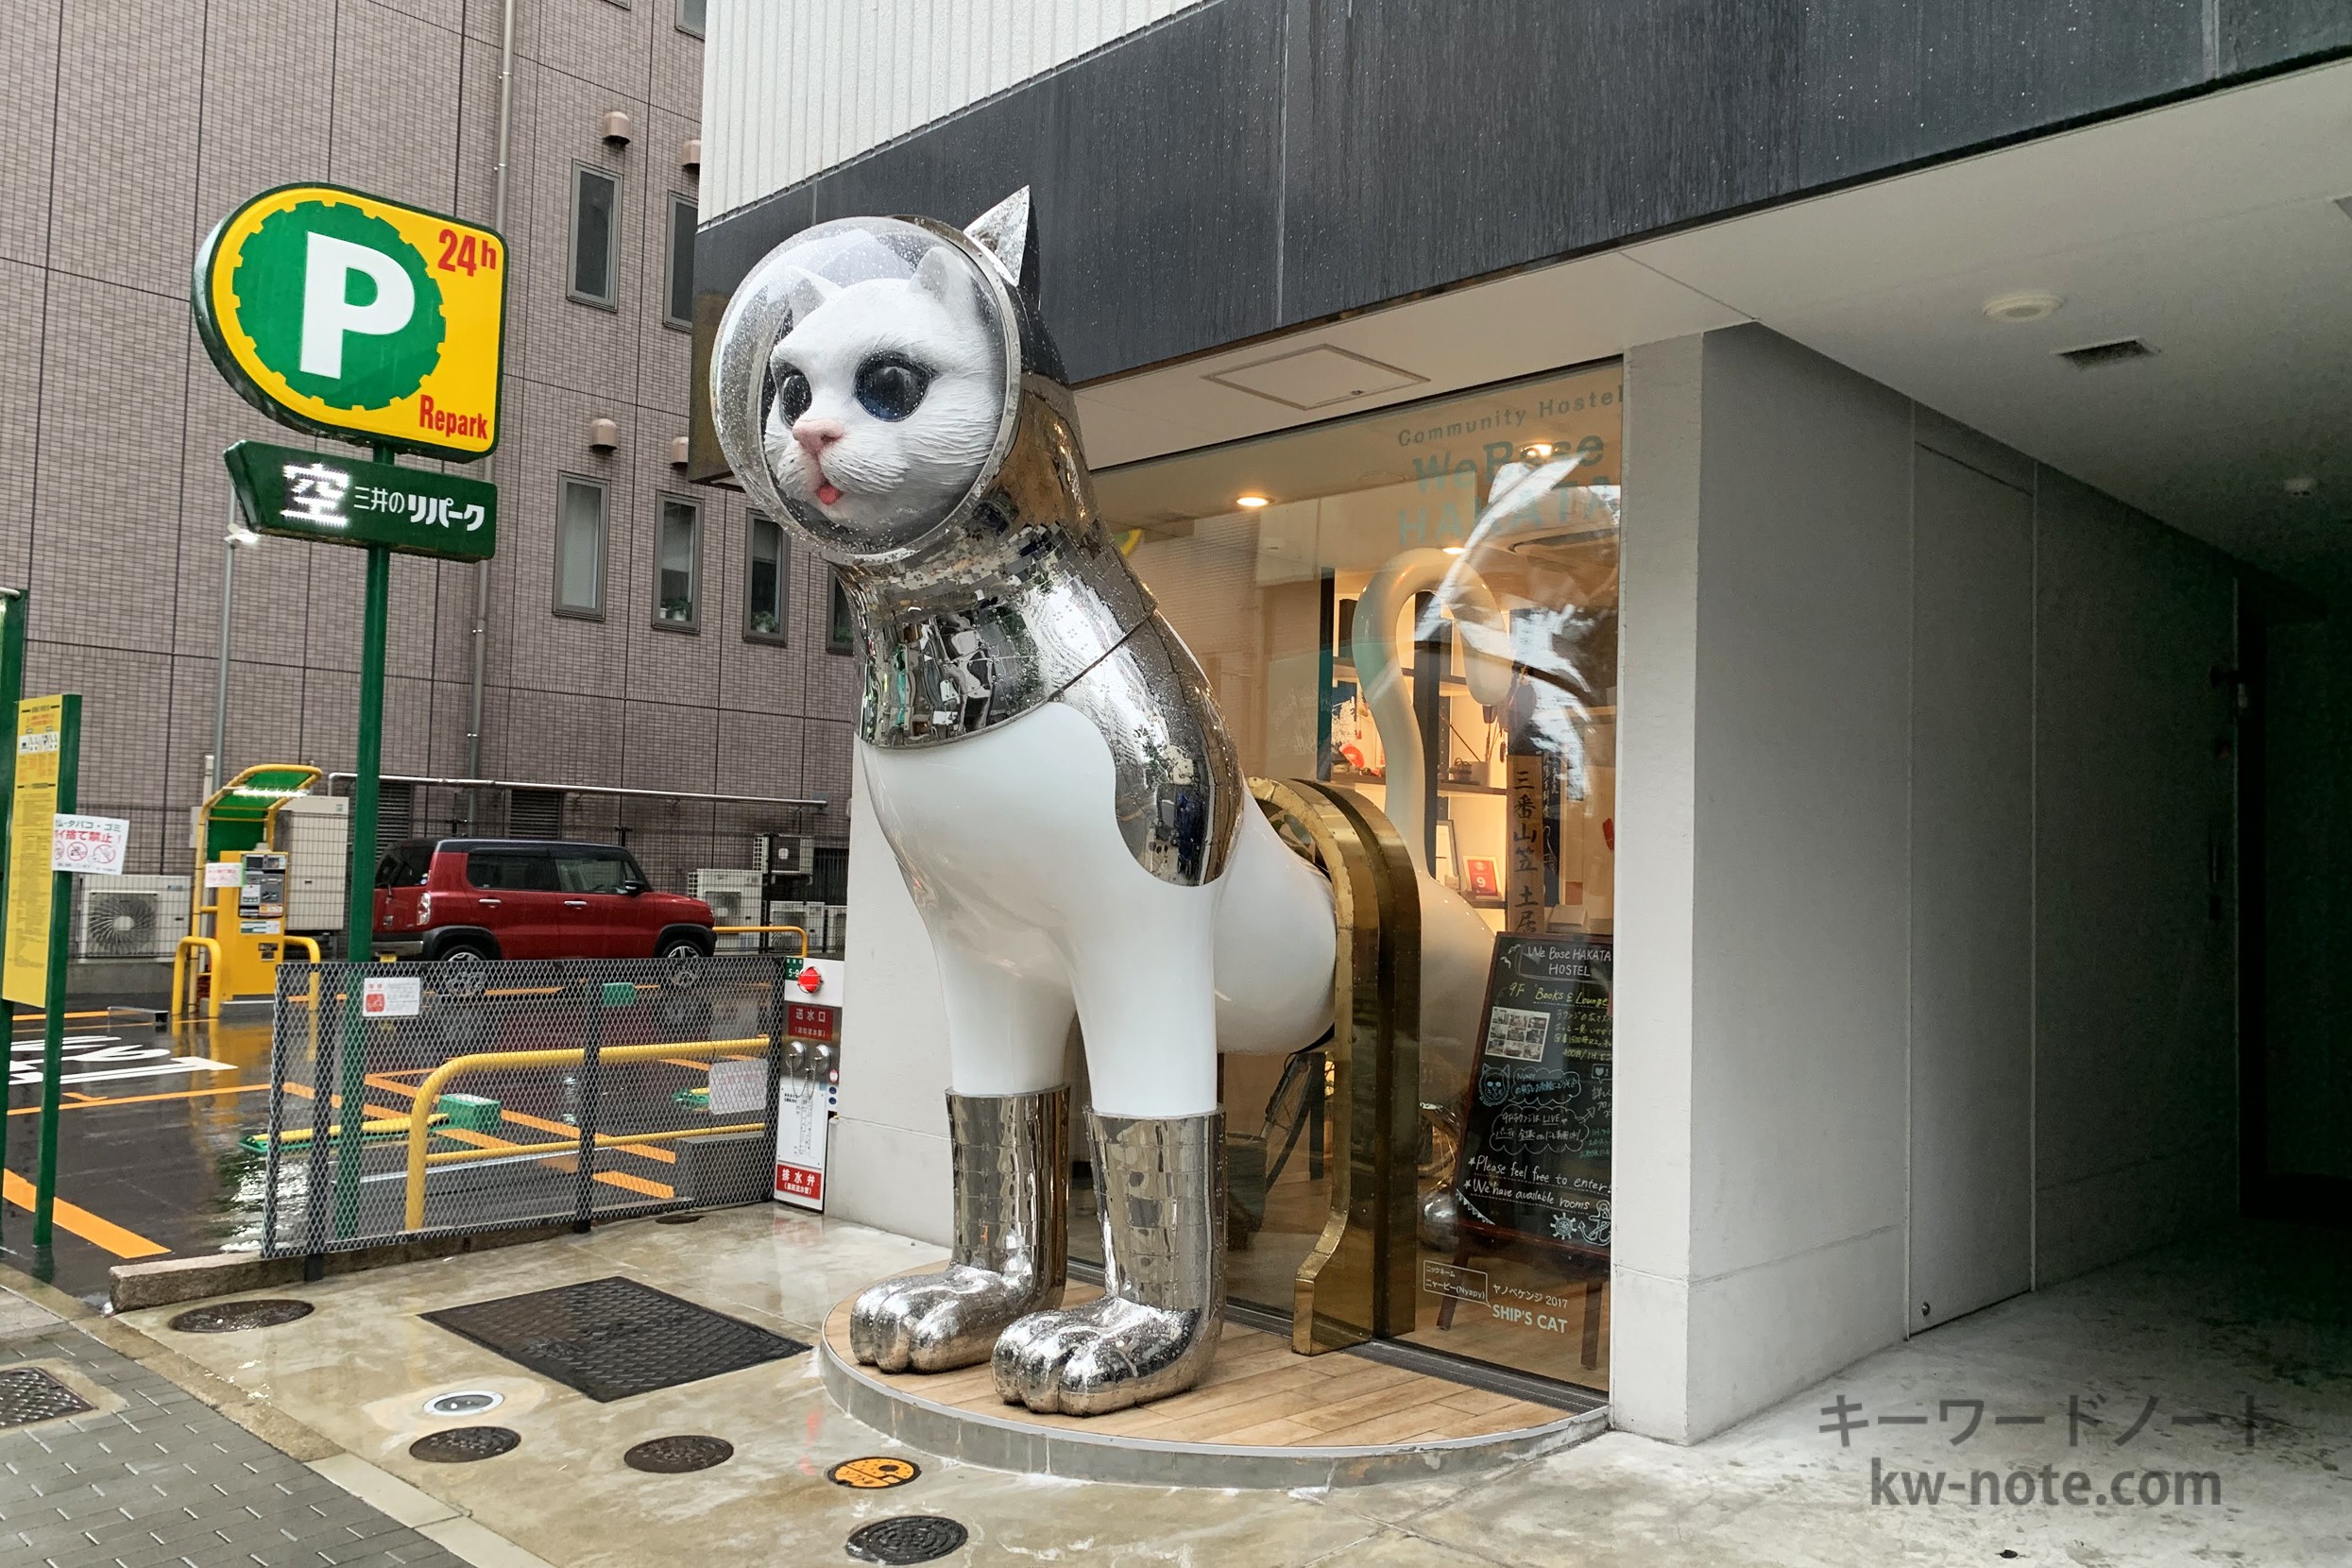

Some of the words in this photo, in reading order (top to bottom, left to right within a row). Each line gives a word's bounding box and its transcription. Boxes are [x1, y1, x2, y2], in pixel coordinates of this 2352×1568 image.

[437, 228, 497, 277] 24h
[299, 230, 416, 380] P
[419, 394, 488, 440] Repark
[1398, 407, 1527, 448] Community
[1539, 383, 1623, 418] Hostel
[281, 462, 351, 528] 空
[353, 485, 486, 532] 三井のリパーク
[1475, 876, 1487, 889] 9
[1527, 946, 1545, 958] We
[1572, 947, 1611, 962] HAKATA
[1549, 963, 1591, 977] HOSTEL
[1509, 982, 1525, 997] 9F
[1575, 992, 1609, 1008] Lounge
[1475, 1154, 1507, 1174] Please
[1510, 1161, 1528, 1180] feel
[1532, 1166, 1550, 1183] free
[1555, 1173, 1568, 1185] to
[1473, 1178, 1491, 1194] We
[1492, 1182, 1513, 1198] have
[1515, 1189, 1555, 1204] available
[1559, 1197, 1591, 1211] rooms
[1425, 1265, 1456, 1278] ニックネーム
[1492, 1283, 1543, 1303] ヤノベケンジ
[1545, 1295, 1568, 1309] 2017
[1492, 1304, 1533, 1326] SHIP'S
[1537, 1314, 1568, 1334] CAT
